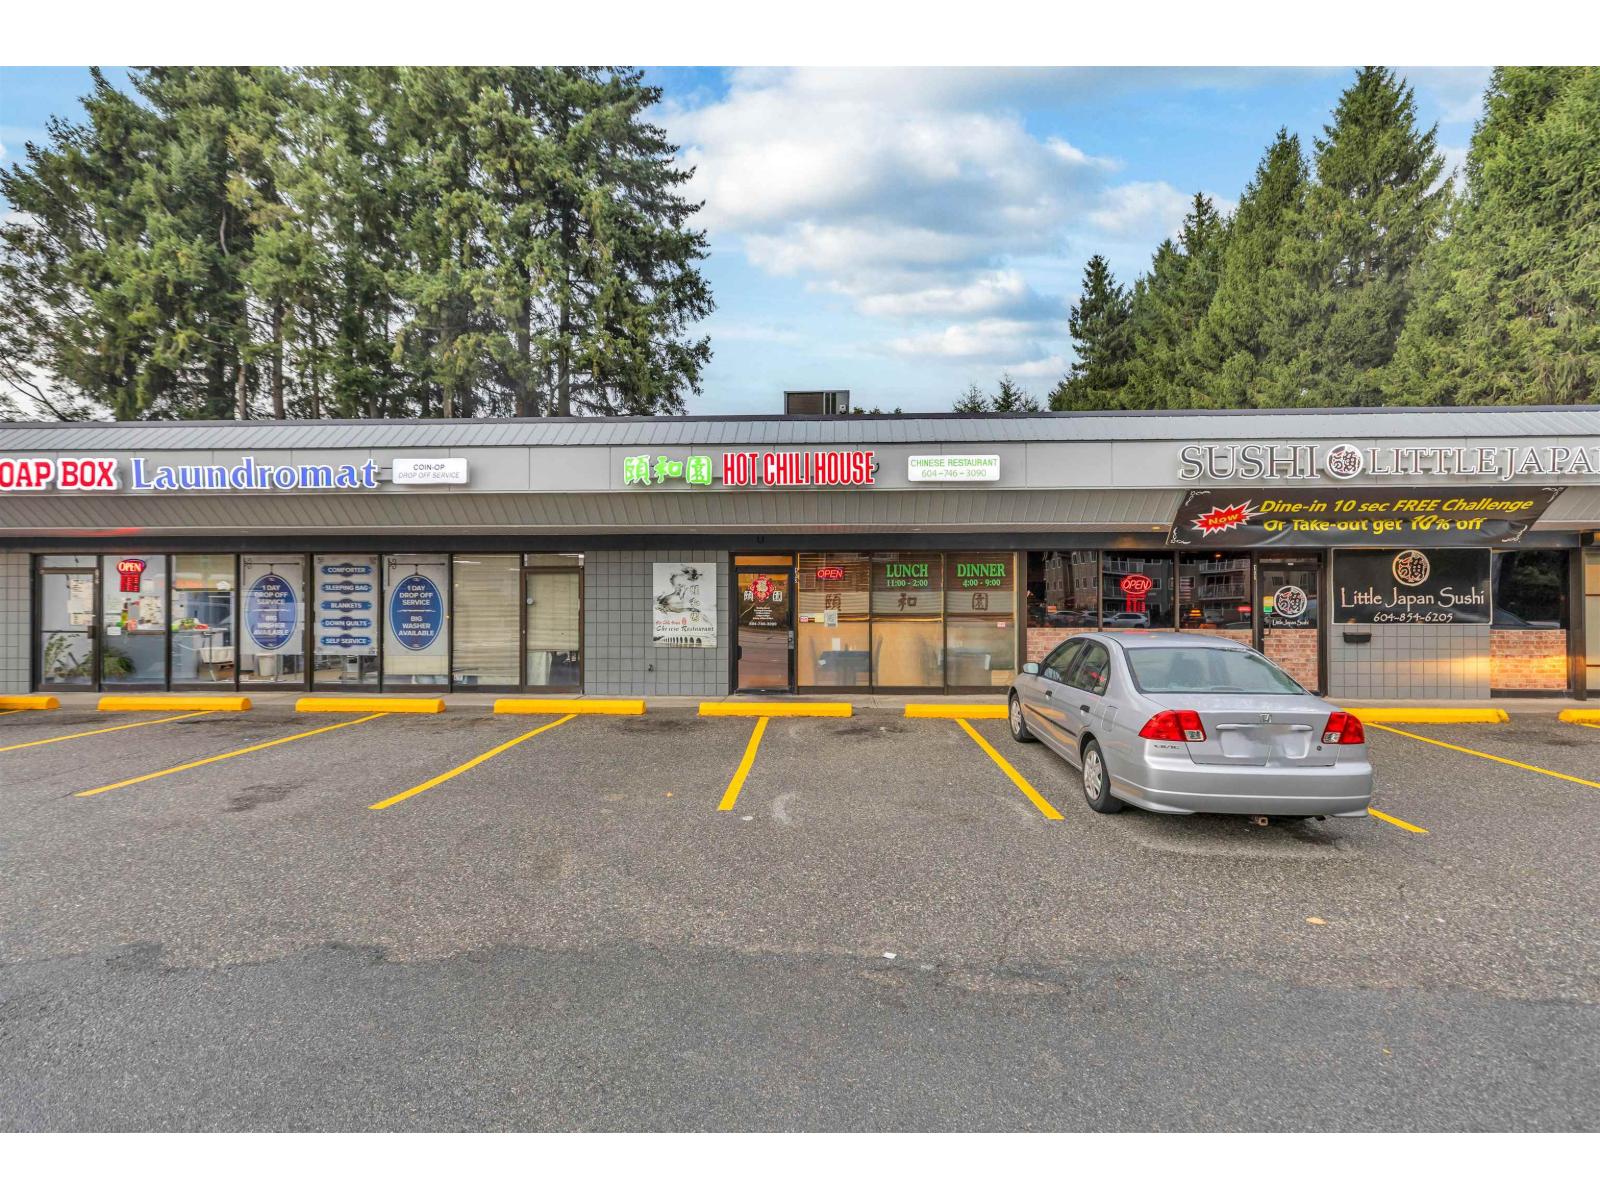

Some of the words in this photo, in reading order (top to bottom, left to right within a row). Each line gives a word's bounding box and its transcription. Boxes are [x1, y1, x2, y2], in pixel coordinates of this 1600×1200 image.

[722, 452, 759, 486] HOT
[763, 451, 810, 486] CHILI
[814, 451, 875, 485] HOUSE
[911, 459, 945, 467] CHINESE
[948, 458, 998, 467] RESTAURANT
[1179, 444, 1321, 480] SUSHI
[1368, 447, 1499, 475] LITTLE
[1503, 446, 1600, 481] JAPA
[60, 460, 115, 489] BOX
[131, 457, 378, 489] Laundromat
[399, 471, 417, 479] DROP
[432, 471, 460, 479] SERVICE
[1260, 499, 1328, 513] Dine-in
[1334, 500, 1357, 512] 10
[1358, 502, 1390, 512] sec
[1392, 500, 1441, 512] FREE
[1442, 498, 1534, 513] Challenge
[1263, 520, 1287, 532] Or
[1292, 519, 1369, 531] Take-out
[1372, 519, 1403, 535] get
[1411, 515, 1450, 530] 10%
[1456, 518, 1488, 530] off
[118, 562, 142, 572] OPEN
[817, 569, 843, 578] OPEN
[886, 564, 929, 578] LUNCH
[957, 563, 1006, 577] DINNER
[886, 579, 906, 587] 11:00
[913, 579, 929, 587] 2:00
[962, 578, 978, 587] 4:00
[984, 578, 1001, 587] 9:00
[1122, 579, 1149, 590] OPEN
[1340, 587, 1382, 608] Little
[1385, 587, 1435, 612] Japan
[1438, 586, 1485, 608] Sushi
[1373, 612, 1453, 623] 604-854-6205
